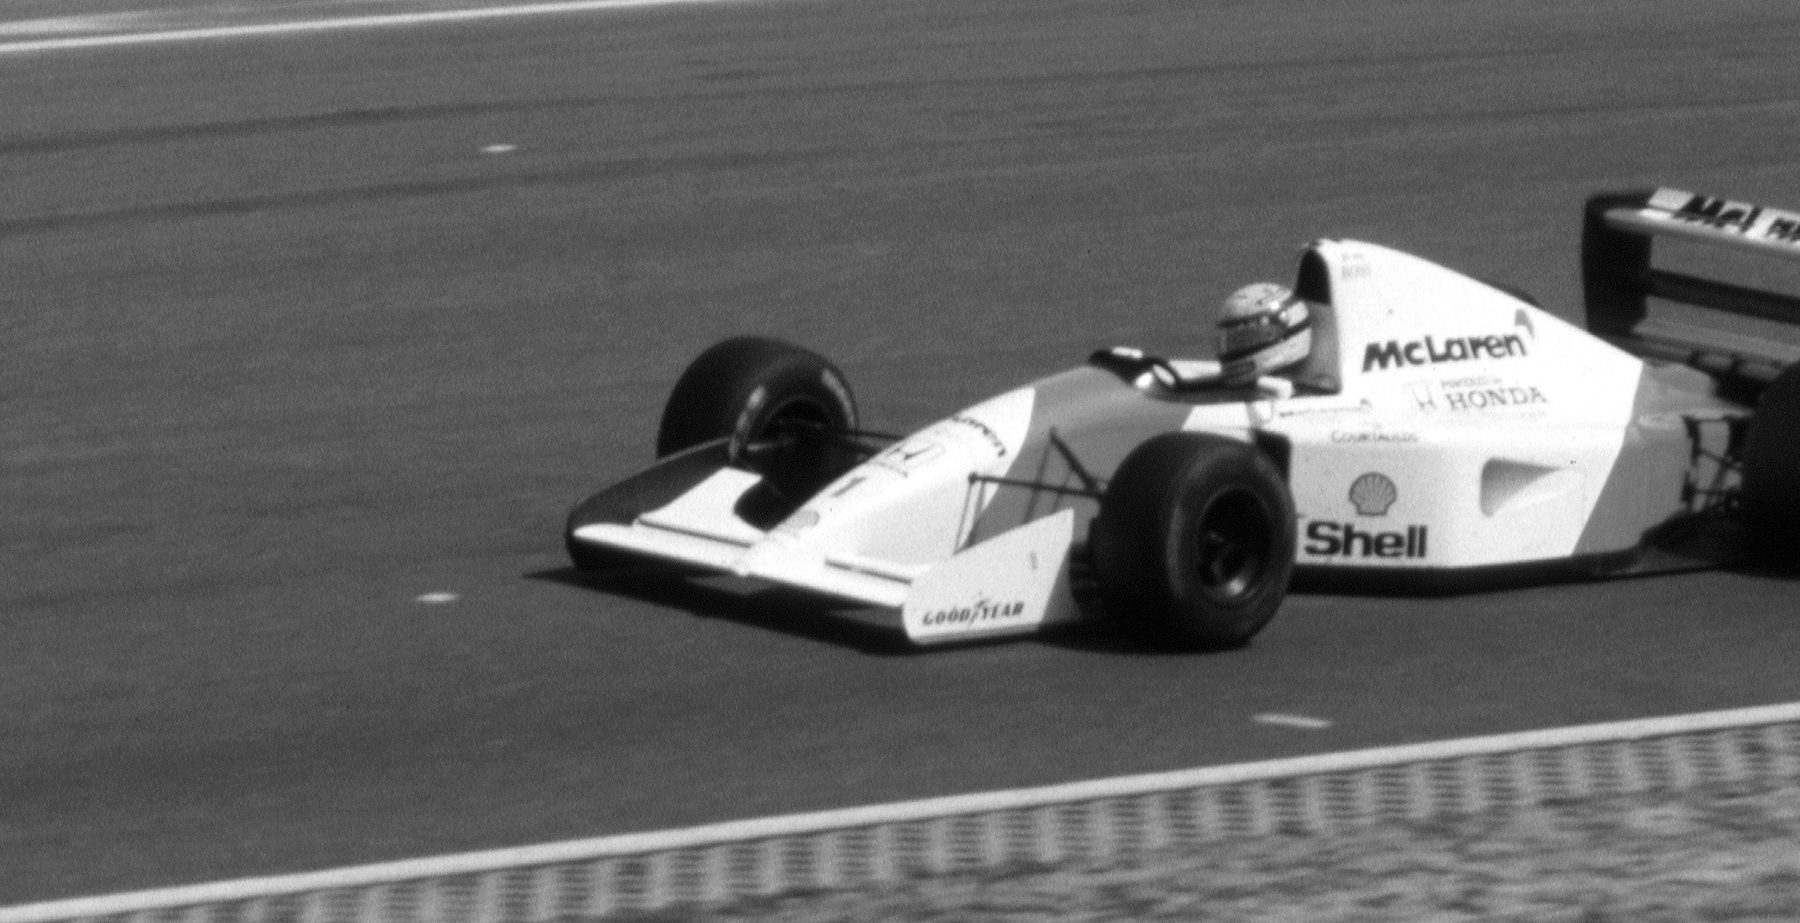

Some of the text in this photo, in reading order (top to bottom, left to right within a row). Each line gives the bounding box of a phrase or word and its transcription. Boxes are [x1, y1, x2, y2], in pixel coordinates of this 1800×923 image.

[1361, 334, 1528, 374] McLaren
[1444, 386, 1548, 411] HONDA
[1304, 519, 1429, 559] Shell
